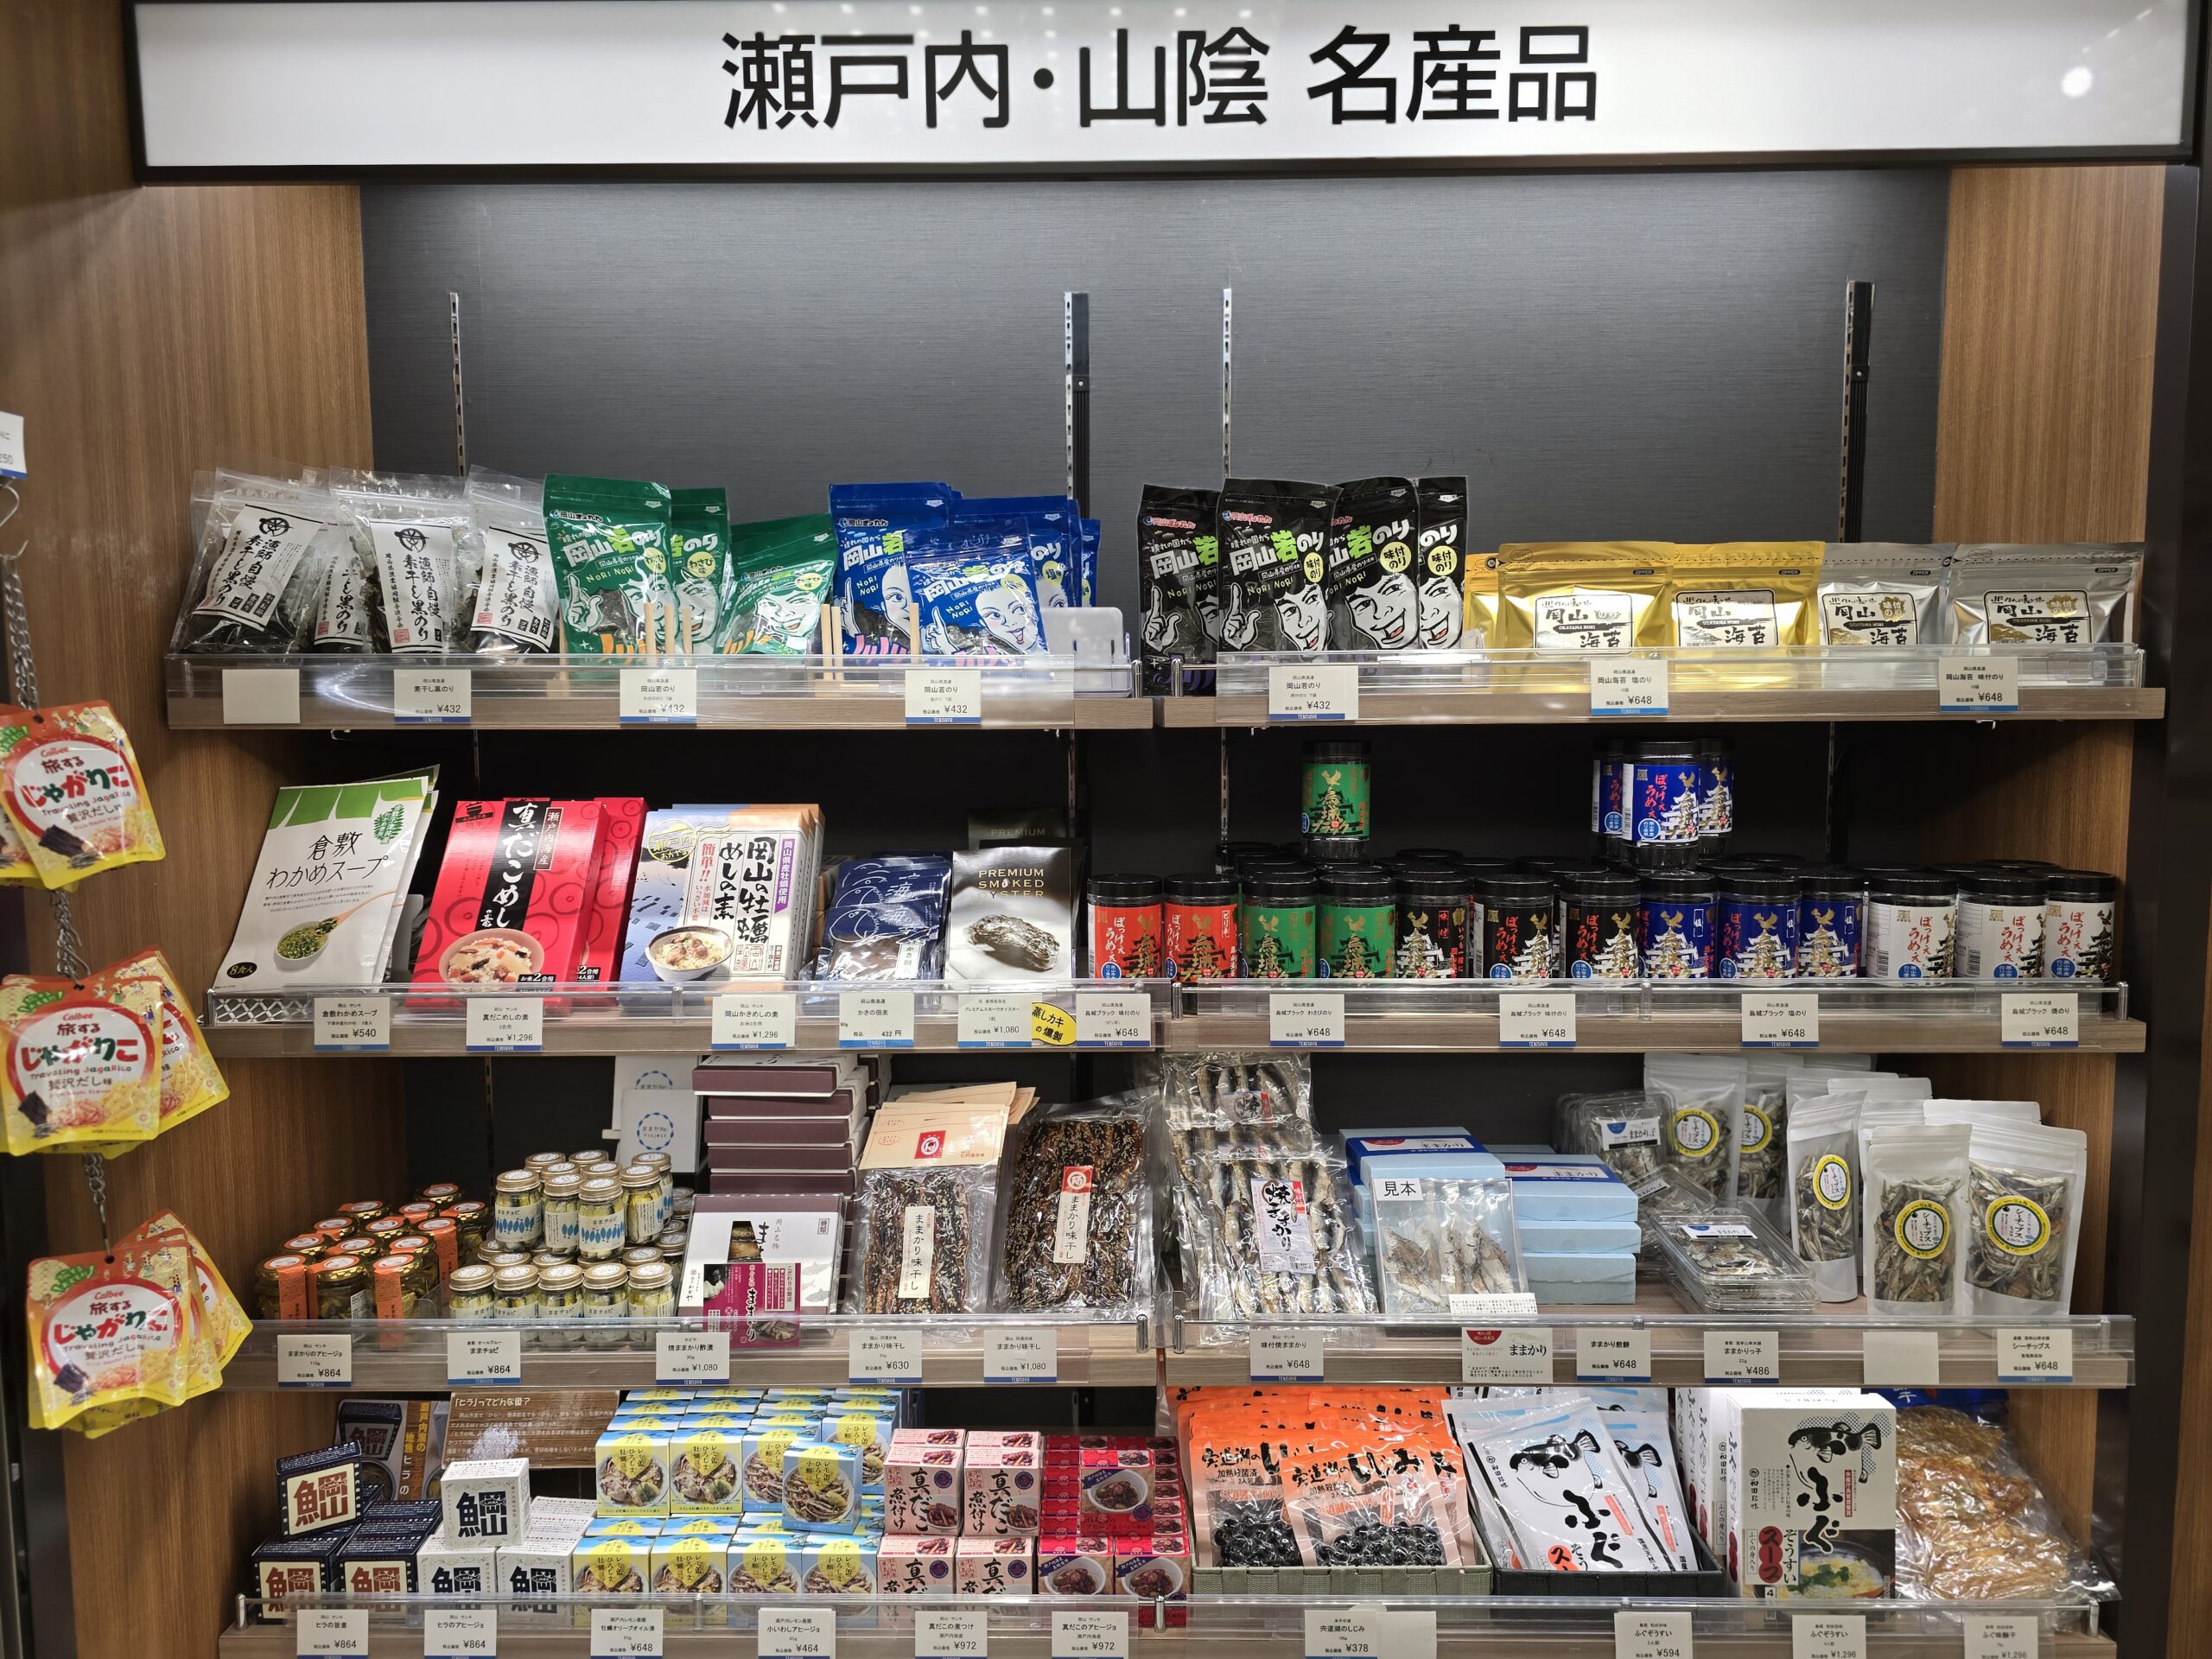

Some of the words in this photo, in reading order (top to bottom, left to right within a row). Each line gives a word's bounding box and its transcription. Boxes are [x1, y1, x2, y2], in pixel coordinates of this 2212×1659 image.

[722, 29, 1269, 130] 瀬戸内・山陰
[1306, 25, 1597, 124] 名産品
[1420, 524, 1458, 546] のり
[1230, 530, 1324, 576] 岡山若のり
[1384, 548, 1406, 560] 味付
[1432, 549, 1452, 562] 味付
[1306, 558, 1320, 569] 味付
[1389, 557, 1407, 569] のり
[1435, 560, 1452, 571] のり
[214, 535, 264, 606] 素干し黒のり
[1310, 569, 1321, 578] のり
[419, 556, 442, 618] 漁師自慢
[403, 554, 429, 642] 素干し黒のり
[1546, 608, 1588, 624] 岡山
[1835, 606, 1876, 620] 岡山
[1997, 605, 2043, 617] 岡山
[1725, 626, 1765, 645] 海苔
[1870, 627, 1907, 645] 海苔
[2036, 624, 2079, 643] 海苔
[1627, 696, 1652, 705] ¥648
[1977, 692, 2003, 702] ¥648
[436, 704, 461, 714] ¥432
[660, 703, 685, 713] ¥432
[944, 704, 968, 714] ¥432
[1306, 700, 1331, 709] ¥432
[41, 756, 85, 774] 旅する
[21, 766, 130, 808] じゃがりこ
[991, 828, 1046, 836] PREMIUM
[537, 811, 560, 867] 瀬戸内海産
[307, 831, 363, 861] 倉敷
[493, 803, 538, 928] 真だこめし
[265, 855, 389, 889] わかめスープ
[979, 868, 1045, 878] PREMIUM
[713, 842, 744, 920] めしの素
[737, 836, 777, 944] 岡山の牡蠣
[978, 890, 1044, 899] OYSTER
[229, 963, 253, 976] 8食入
[62, 1012, 94, 1021] Calbee
[321, 1009, 378, 1018] 倉敷わかめスープ
[1033, 1007, 1064, 1027] 蒸しカキ
[56, 1022, 100, 1036] 旅する
[352, 1028, 377, 1038] ¥540
[752, 1030, 779, 1039] ¥1,296
[1115, 1027, 1139, 1037] ¥648
[1306, 1027, 1331, 1037] ¥648
[1541, 1028, 1566, 1038] ¥648
[1780, 1028, 1806, 1038] ¥648
[2044, 1026, 2069, 1035] ¥648
[506, 1033, 533, 1042] ¥1,296
[21, 1036, 139, 1072] じゃがりこ
[1383, 1181, 1416, 1197] 見本
[593, 1216, 618, 1225] ままチョビ
[2015, 1209, 2024, 1239] シーチップス
[1064, 1196, 1079, 1261] ままかり味干し
[1922, 1211, 1931, 1243] シーチップス
[909, 1214, 925, 1291] ままかり味干し
[94, 1290, 124, 1300] Calbee
[90, 1300, 131, 1315] 旅する
[54, 1309, 168, 1344] じゃがりこ
[1590, 1340, 1630, 1349] ままかり煎餅
[467, 1346, 499, 1355] ままチョビ
[1509, 1344, 1548, 1357] ままかり
[487, 1364, 511, 1374] ¥864
[885, 1361, 910, 1370] ¥630
[1020, 1362, 1046, 1370] ¥1,080
[1287, 1359, 1311, 1369] ¥648
[1612, 1359, 1637, 1369] ¥648
[2034, 1361, 2058, 1370] ¥648
[317, 1368, 341, 1377] ¥864
[1745, 1366, 1770, 1376] ¥486
[909, 1467, 931, 1532] 真だこ
[989, 1469, 1012, 1534] 真だこ
[889, 1487, 906, 1533] 煮付け
[969, 1491, 986, 1533] 煮付け
[1796, 1466, 1844, 1553] ふぐ
[1563, 1489, 1624, 1568] ふぐ
[1762, 1530, 1779, 1580] スープ
[1783, 1529, 1797, 1583] ぞうすい
[1319, 1624, 1365, 1633] 宍道湖のしじみ
[334, 1639, 357, 1649] ¥864
[463, 1639, 486, 1649] ¥864
[630, 1643, 653, 1652] ¥648
[796, 1643, 818, 1653] ¥464
[953, 1641, 976, 1650] ¥972
[1091, 1642, 1116, 1650] ¥972
[1344, 1643, 1369, 1653] ¥378
[1656, 1648, 1680, 1657] ¥594
